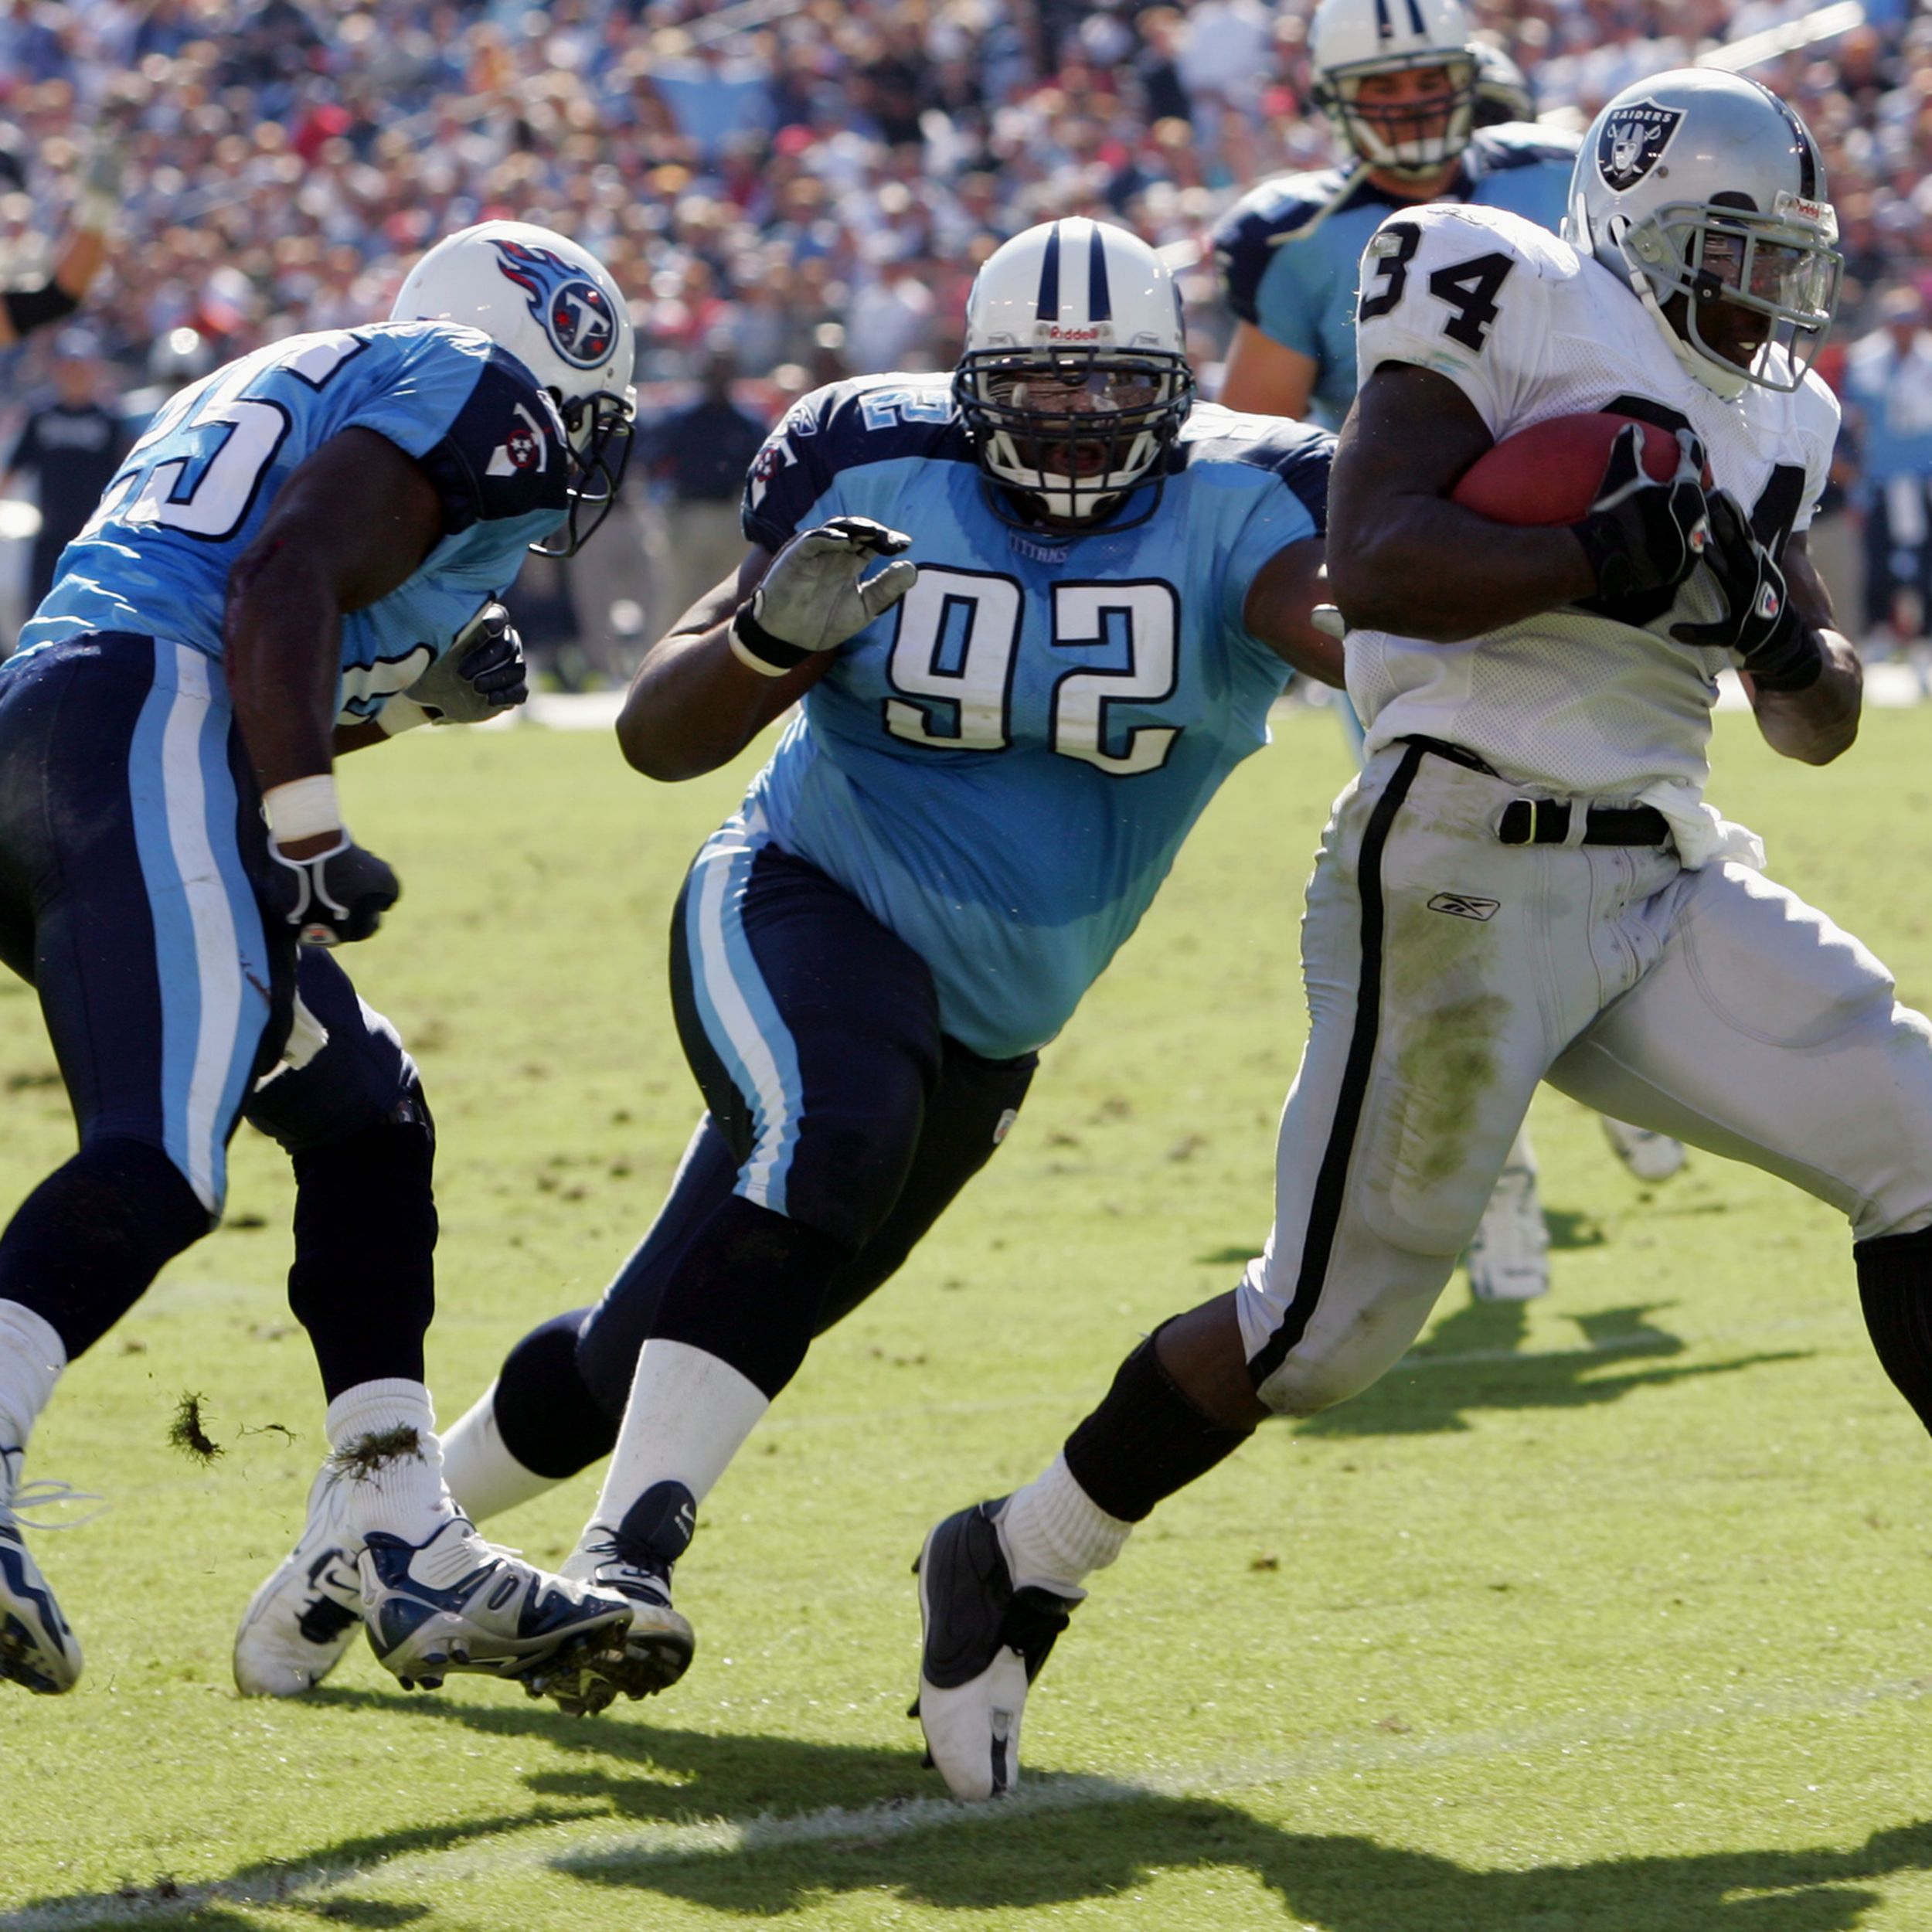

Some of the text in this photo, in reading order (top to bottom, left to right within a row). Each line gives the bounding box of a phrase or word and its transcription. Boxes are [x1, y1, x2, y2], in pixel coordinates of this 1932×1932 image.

[1611, 109, 1672, 123] RAIDERS
[1359, 220, 1516, 357] 34
[1049, 325, 1099, 340] Riddell
[1012, 534, 1070, 564] TITANS
[882, 562, 1186, 778] 92
